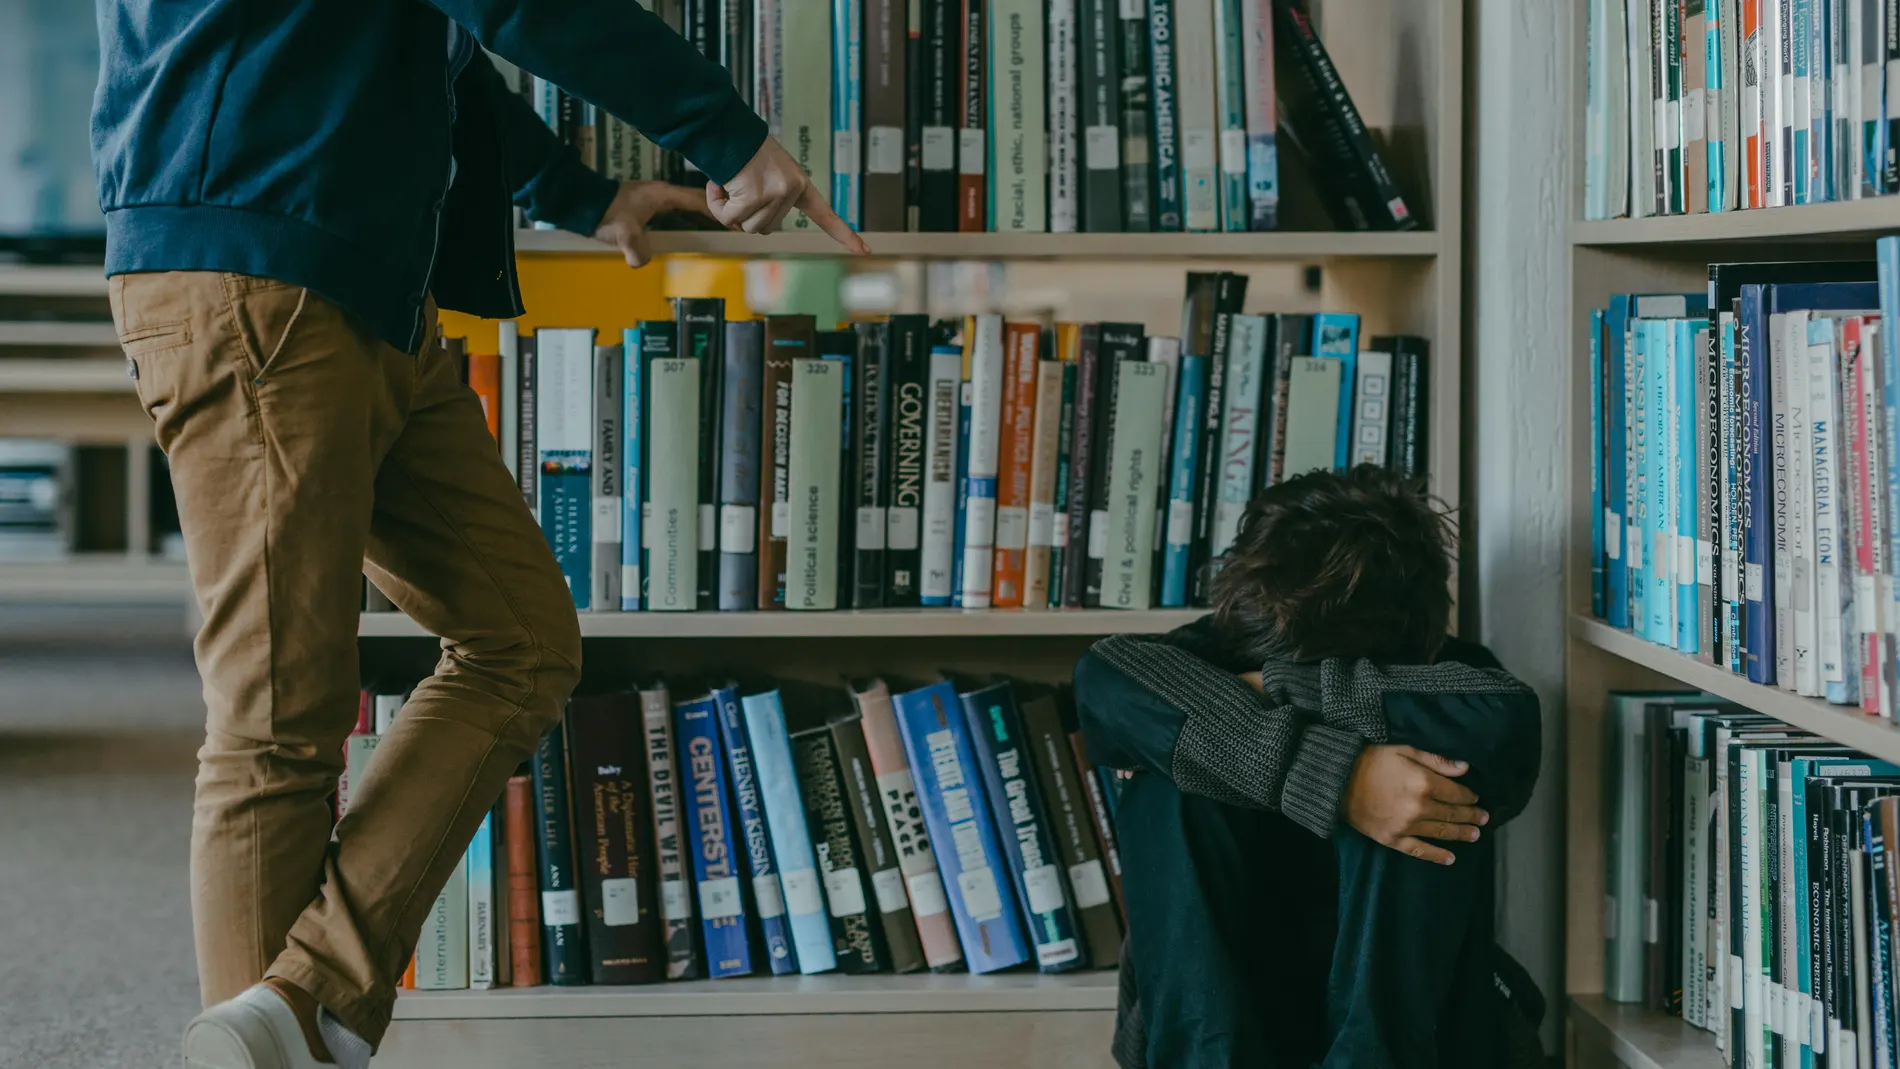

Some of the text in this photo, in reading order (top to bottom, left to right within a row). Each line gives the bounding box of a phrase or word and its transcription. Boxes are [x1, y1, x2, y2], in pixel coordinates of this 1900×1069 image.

[1009, 12, 1025, 67] groups
[1668, 0, 1680, 67] dgetary and
[1780, 4, 1790, 63] Changing World
[1796, 7, 1808, 69] Economy
[1010, 69, 1022, 130] national
[1153, 3, 1175, 169] TOO SING AMERICA
[611, 118, 623, 169] affecti
[799, 125, 811, 179] groups
[1010, 178, 1026, 230] Racial,
[1019, 332, 1035, 383] WOMEN
[1213, 313, 1228, 352] MARTIN
[663, 361, 686, 373] 307
[807, 362, 829, 374] 320
[1210, 354, 1224, 387] LUTHER
[1656, 372, 1661, 380] A
[1774, 339, 1783, 403] Mansfield
[775, 380, 788, 464] FOR DECISION
[864, 363, 880, 497] POLITICAL THEORY
[898, 382, 924, 507] GOVERNING
[933, 379, 953, 483] LIBERTARIANISM
[1013, 405, 1030, 464] POLITICS
[1225, 406, 1253, 481] KING
[1637, 365, 1645, 522] INSIDE
[1657, 443, 1662, 458] OF
[1708, 337, 1720, 556] MICROECONOMICS
[1727, 415, 1736, 469] forecasting:
[1741, 324, 1752, 529] MICROECONOMICS
[1884, 406, 1896, 471] STARTING
[602, 420, 614, 495] FAMILY AND
[1698, 400, 1707, 536] The Economics of Art and
[1865, 393, 1879, 540] ENTREPRENEURS
[1735, 393, 1746, 605] MICROECONOMICS
[1813, 421, 1831, 565] MANAGERIAL ECON
[1852, 450, 1865, 547] ECONOMICS
[568, 497, 579, 554] LILLIAN
[804, 485, 820, 607] Political science
[1117, 449, 1143, 606] Civil & political rights
[665, 508, 679, 606] Communities
[1729, 612, 1737, 658] Cambridge
[362, 737, 380, 750] 32
[996, 748, 1018, 780] The
[543, 785, 555, 816] HER
[608, 782, 620, 814] of the
[647, 726, 681, 873] THE DEVIL WE
[730, 746, 759, 814] HENRY
[1004, 778, 1033, 826] Great
[545, 819, 558, 850] LIFE
[593, 783, 611, 876] American People
[619, 791, 637, 852] Diplomatic
[687, 735, 737, 928] CENTERSTE
[886, 790, 915, 858] PEACE
[903, 791, 930, 853] LONG
[1016, 823, 1045, 871] Trans
[1740, 763, 1750, 942] BEYOND THE LIMITS
[1780, 814, 1788, 869] Innovation
[1811, 813, 1820, 841] Hayek
[549, 863, 561, 888] ANN
[1780, 871, 1789, 894] and
[1840, 834, 1850, 977] DEPENDENCY TO ENTERPRISE
[434, 892, 448, 987] International
[855, 926, 873, 964] AND
[1780, 895, 1789, 936] Growth
[1812, 881, 1821, 951] ECONOMIC
[1822, 827, 1834, 1013] Robinson The International Transfer of
[1780, 948, 1788, 964] the
